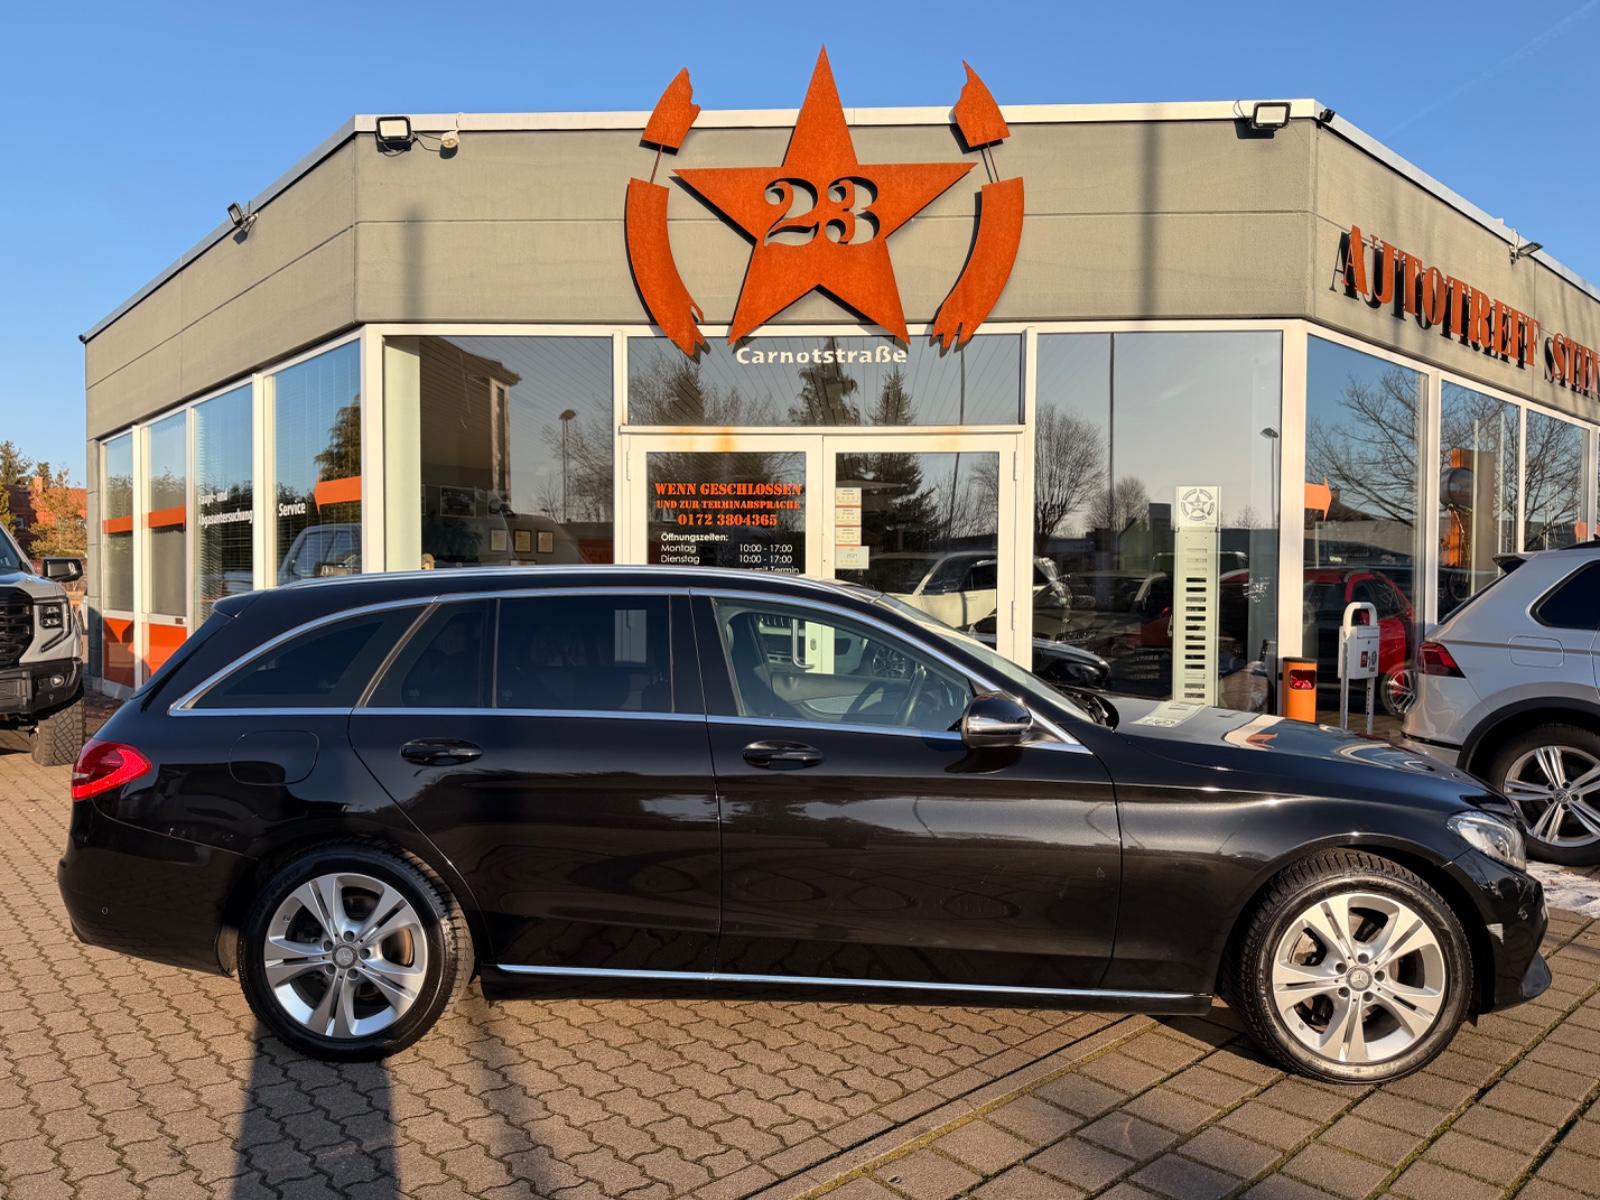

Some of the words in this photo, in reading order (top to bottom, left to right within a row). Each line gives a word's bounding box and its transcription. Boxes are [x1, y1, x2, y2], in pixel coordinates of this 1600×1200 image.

[763, 176, 880, 247] 23
[1342, 224, 1541, 367] AUTOTREFF
[735, 345, 908, 364] Carnotstraße
[655, 482, 697, 496] WENN
[700, 482, 803, 496] GESCHLOSSEN
[278, 500, 306, 517] Service
[656, 500, 677, 510] UND
[679, 500, 699, 510] ZUR
[701, 500, 801, 510] TERMINABSPRACHE
[677, 514, 713, 526] 0172
[716, 514, 778, 526] 3804365
[660, 531, 729, 543] Öffnungszeiten:
[660, 544, 697, 554] Montag
[739, 544, 762, 553] 10:00
[769, 544, 793, 553] 17:00
[660, 554, 700, 565] Dienstag
[739, 555, 762, 564] 10:00
[769, 555, 793, 564] 17:00
[770, 566, 800, 574] Termin
